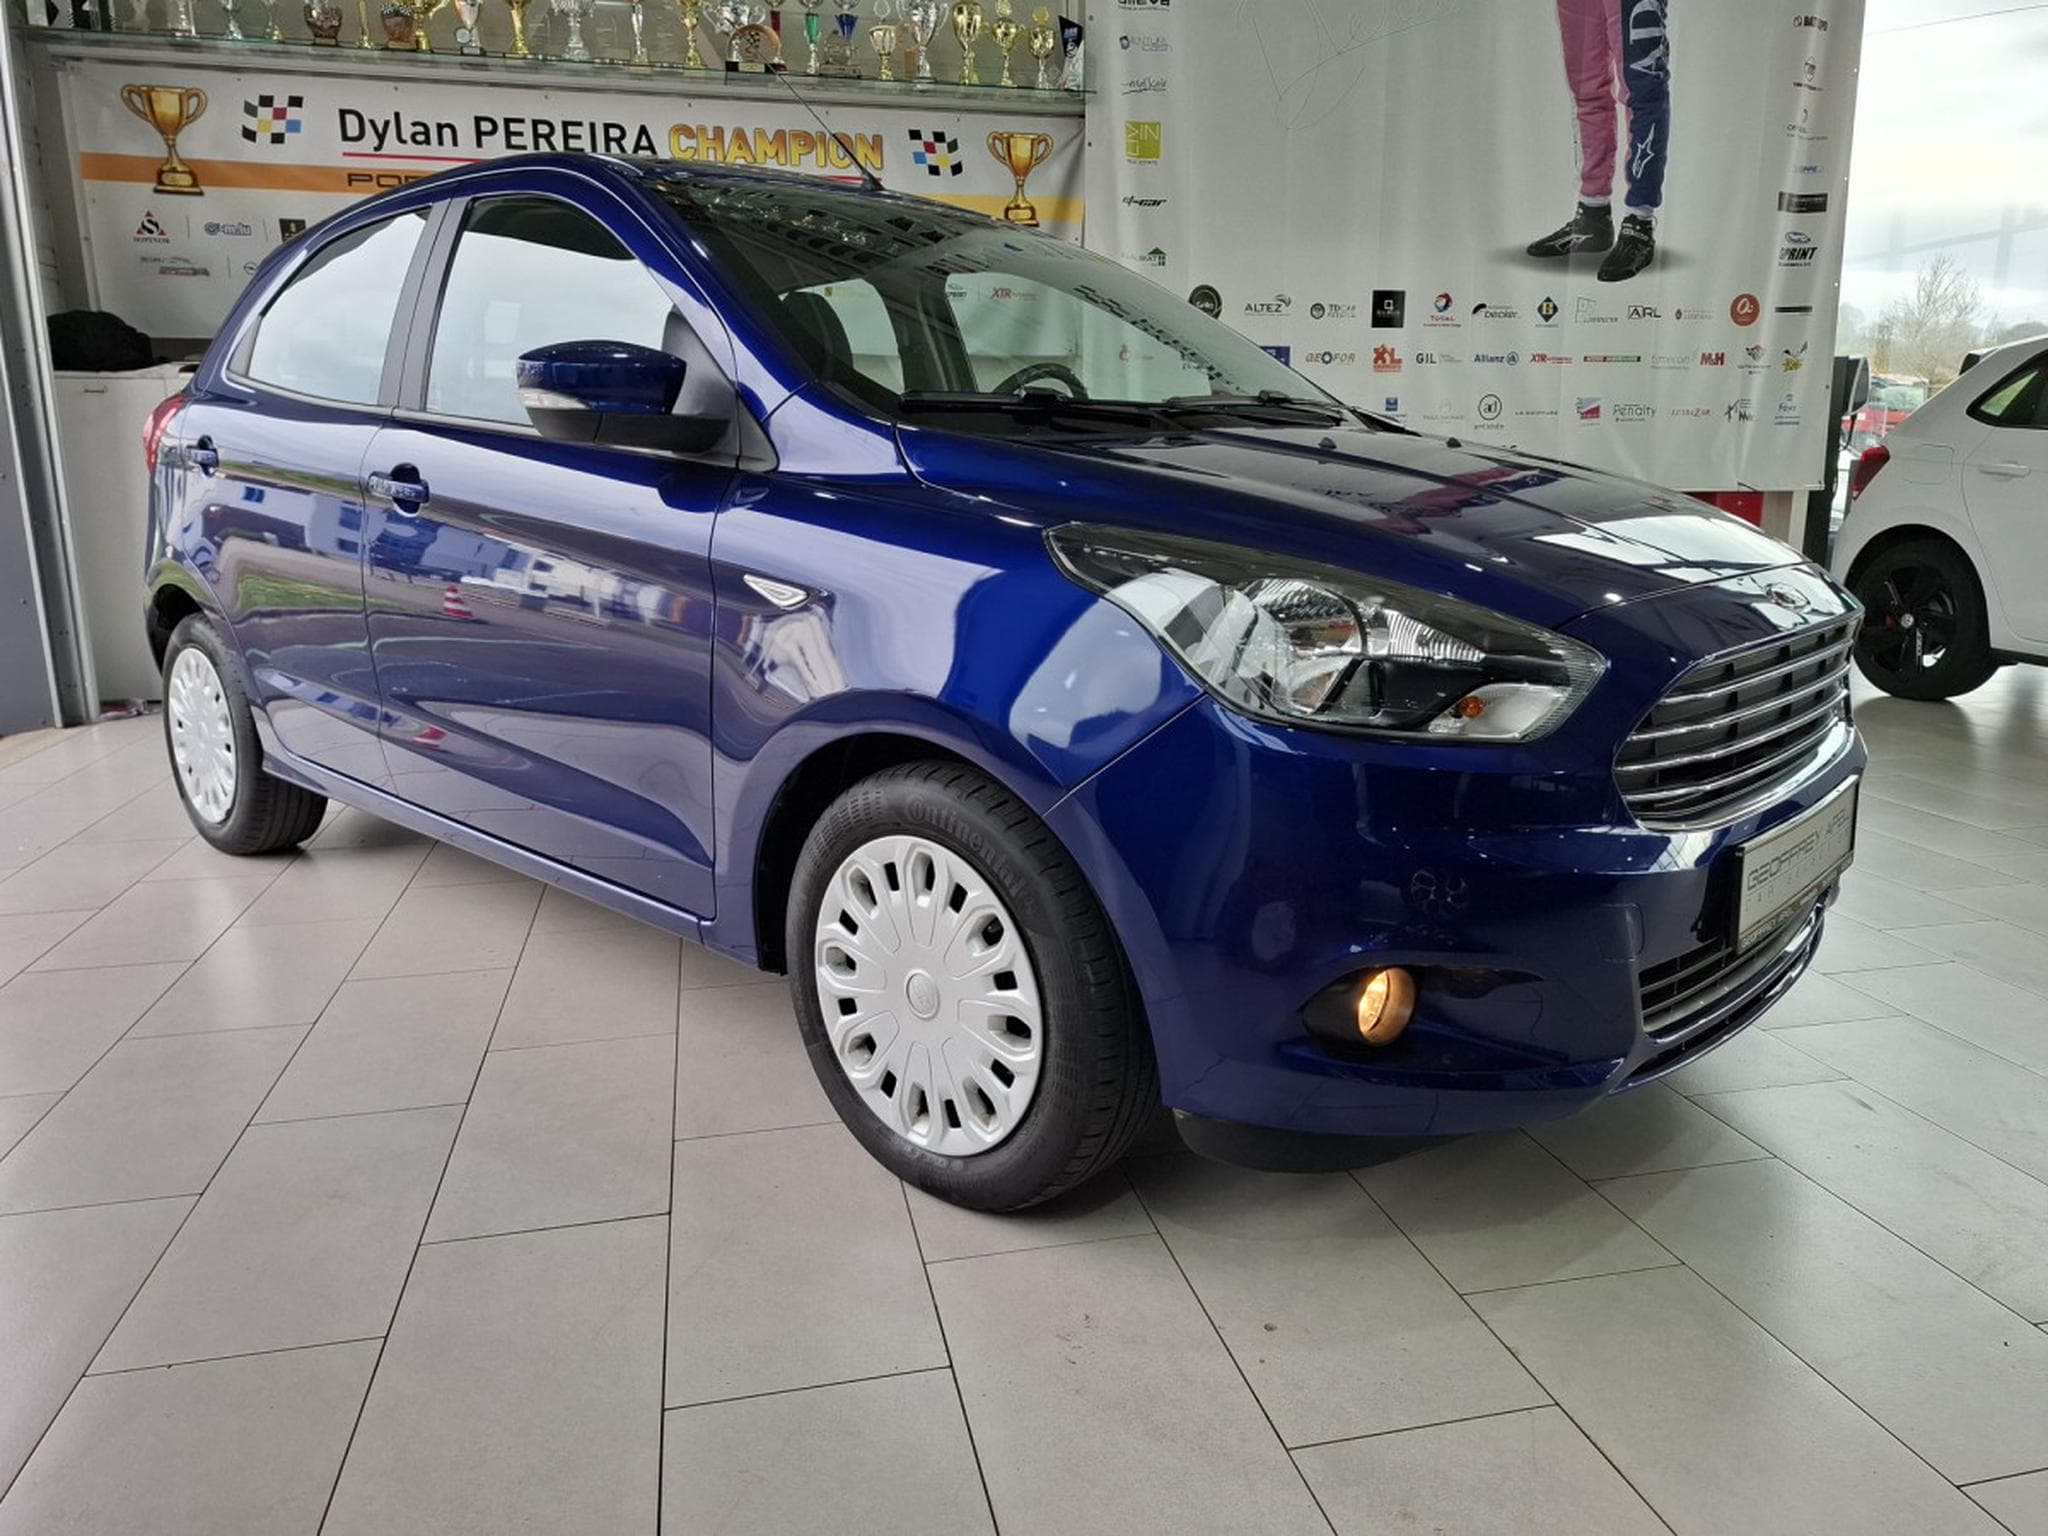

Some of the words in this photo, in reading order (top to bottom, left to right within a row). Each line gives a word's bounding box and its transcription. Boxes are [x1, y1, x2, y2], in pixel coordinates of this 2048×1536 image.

[338, 108, 459, 152] Dylan
[473, 116, 657, 155] PEREIRA
[668, 124, 884, 171] CHAMPION
[1244, 303, 1282, 313] ALTEZ
[1415, 353, 1437, 364] GIL
[1474, 353, 1505, 364] Allianz
